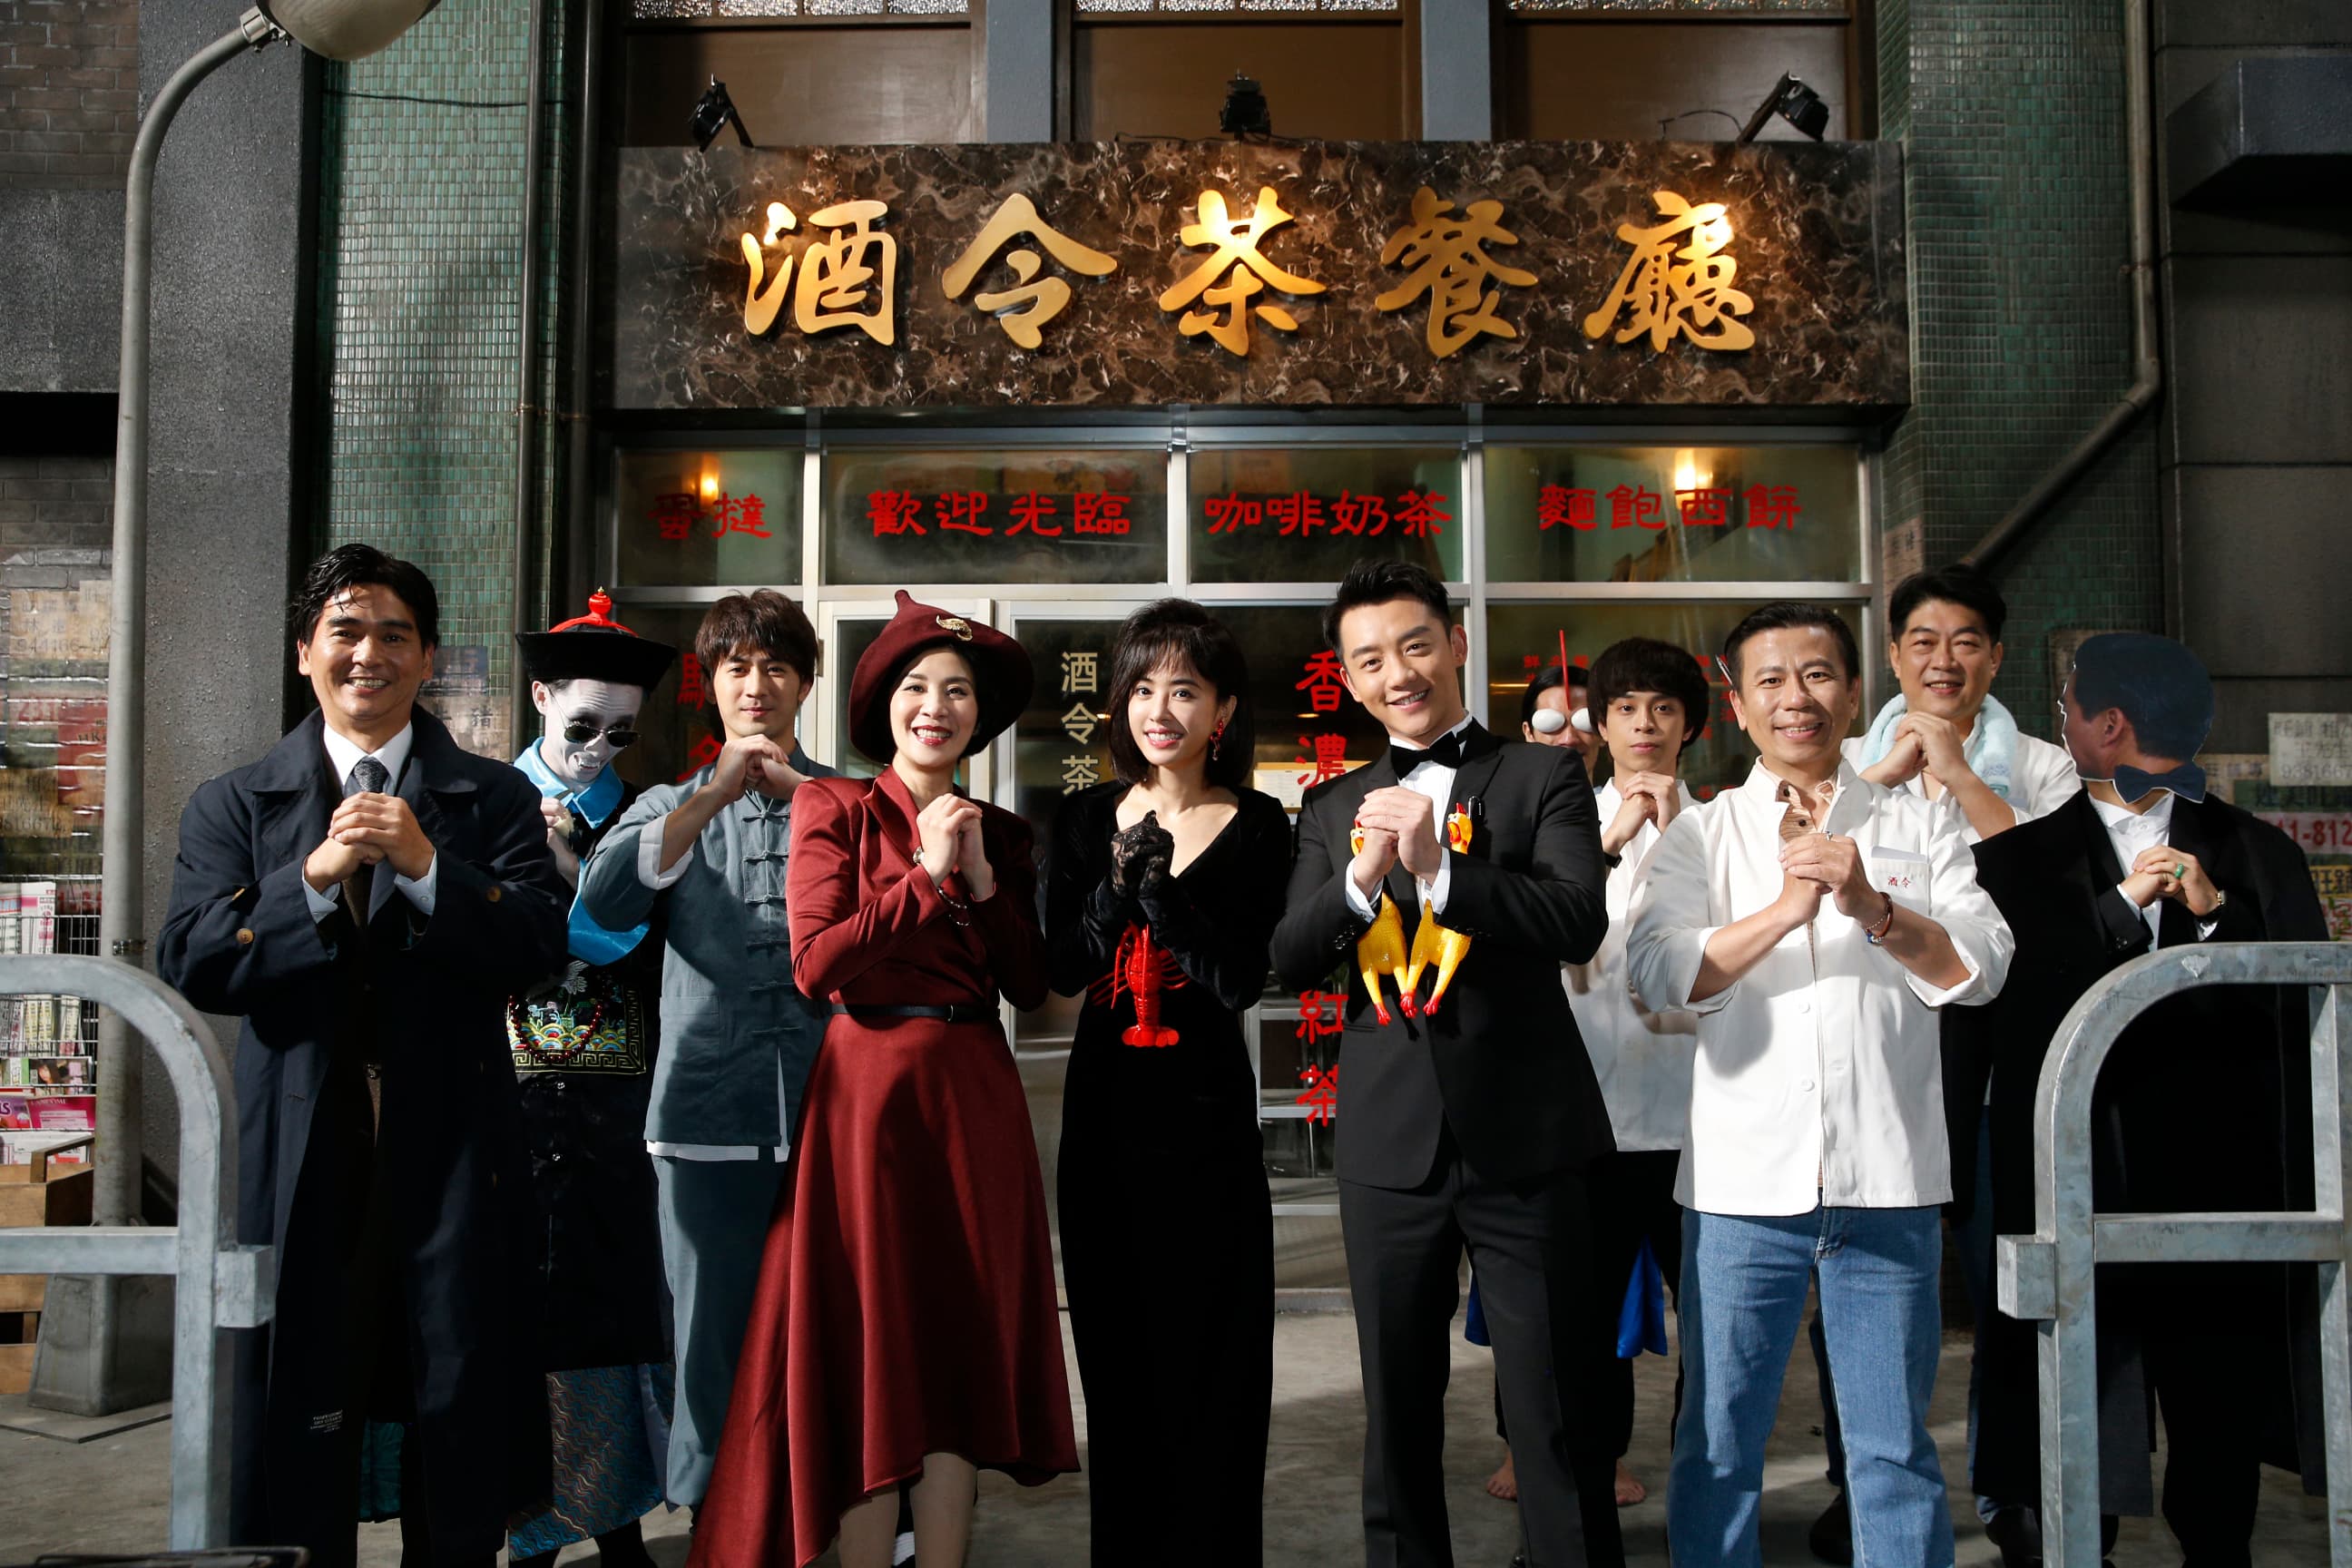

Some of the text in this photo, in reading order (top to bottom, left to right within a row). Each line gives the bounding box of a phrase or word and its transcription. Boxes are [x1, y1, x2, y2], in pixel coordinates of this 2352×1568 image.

[740, 185, 1757, 358] 酒令茶餐廳
[648, 491, 773, 540] 蛋撻
[867, 489, 1132, 537] 歡迎光臨
[1204, 489, 1452, 537] 咖啡奶茶
[1537, 484, 1803, 531] 麵飽西餅
[1061, 652, 1099, 795] 酒令茶
[1295, 989, 1349, 1128] 紅茶
